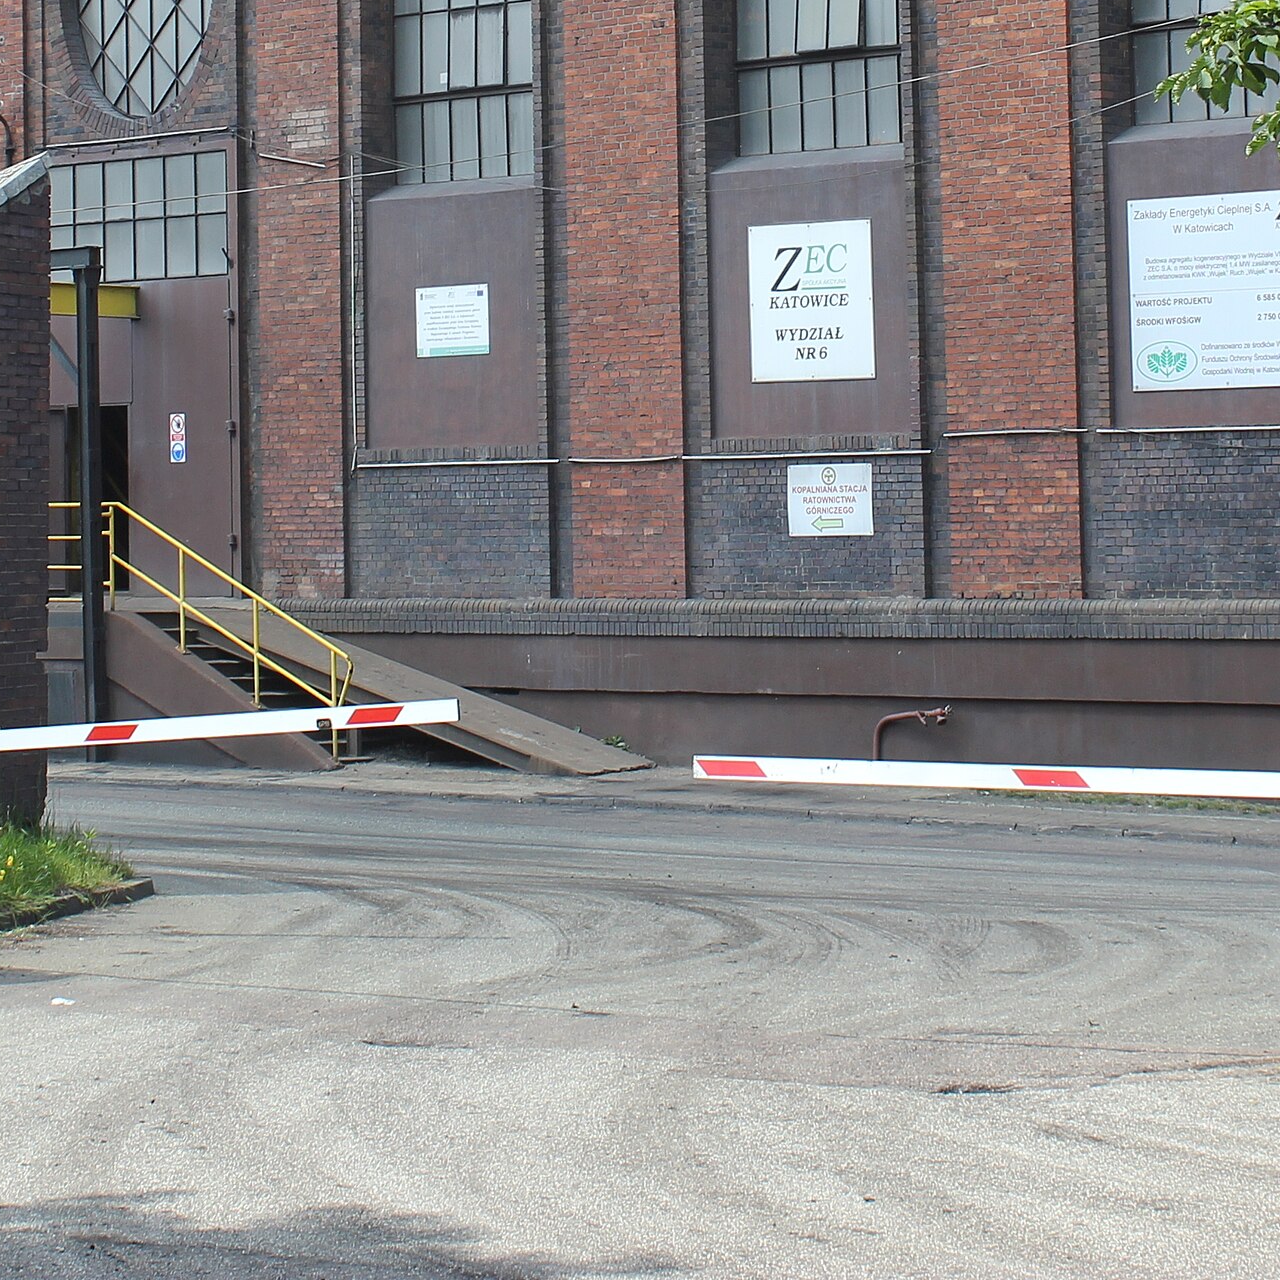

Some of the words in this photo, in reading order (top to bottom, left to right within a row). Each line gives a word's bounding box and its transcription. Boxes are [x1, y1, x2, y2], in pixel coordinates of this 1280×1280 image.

[1134, 210, 1168, 220] Zakłady
[1170, 206, 1214, 218] Energetyki
[1217, 204, 1252, 215] Cieplnej
[1255, 202, 1272, 212] S.A.
[1172, 224, 1182, 234] W
[1184, 222, 1234, 233] Katowicach
[771, 244, 848, 292] ZEC
[770, 294, 849, 309] KATOWICE
[1136, 298, 1172, 307] WARTOŚĆ
[1174, 296, 1212, 306] PROJEKTU
[1136, 316, 1164, 326] ŚRODKI
[775, 326, 844, 342] WYDZIAŁ
[795, 347, 816, 360] NR
[820, 346, 828, 360] 6
[1230, 354, 1252, 362] Ochrony
[1202, 368, 1233, 376] Gospodarki
[1234, 366, 1254, 375] Wodnej
[792, 486, 838, 494] KOPALNIANA
[802, 496, 856, 504] RATOWNICTWA
[806, 506, 854, 514] GÓRNICZEGO
